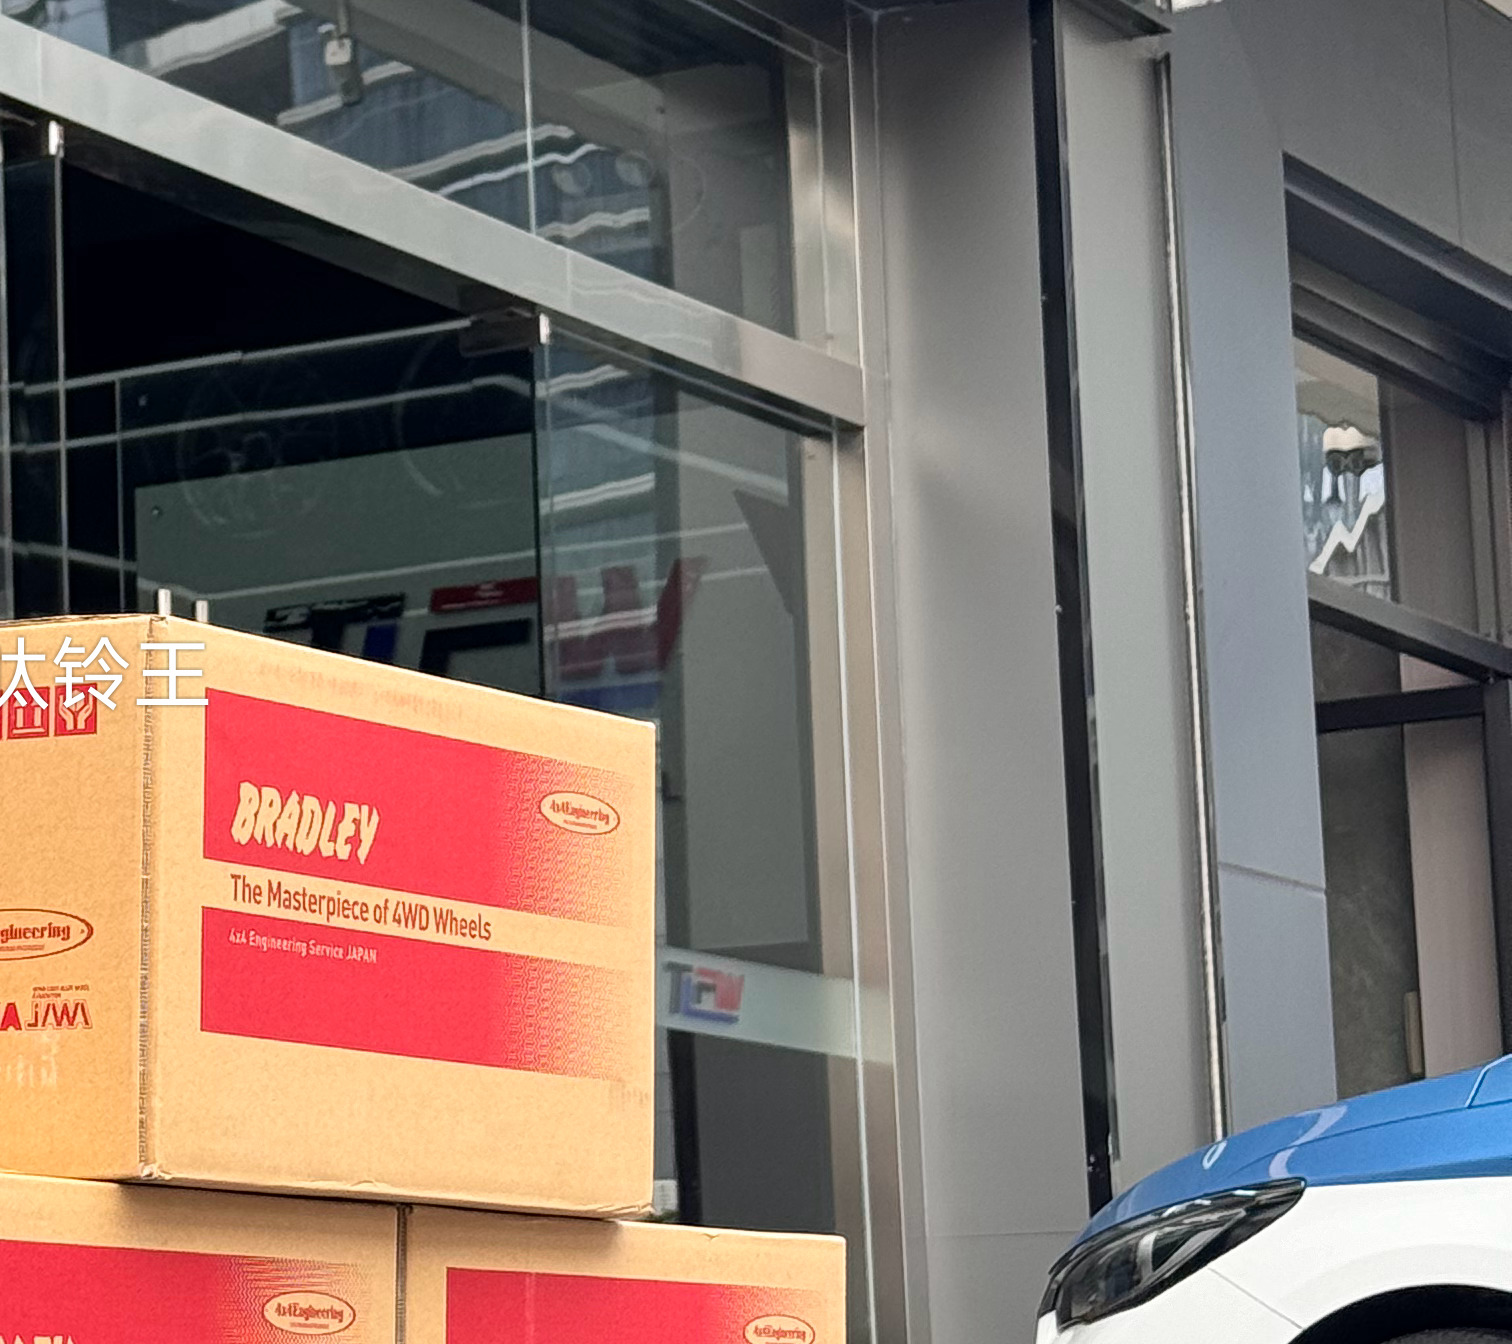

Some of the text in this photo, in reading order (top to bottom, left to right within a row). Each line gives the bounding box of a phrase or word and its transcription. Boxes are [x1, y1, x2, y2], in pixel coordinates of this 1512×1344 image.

[230, 781, 380, 865] BRADLEY
[230, 874, 491, 941] The Masterpiece of 4WD Wheels
[249, 930, 306, 957] Engineering
[309, 939, 343, 959] Service
[346, 945, 377, 963] JAPAN
